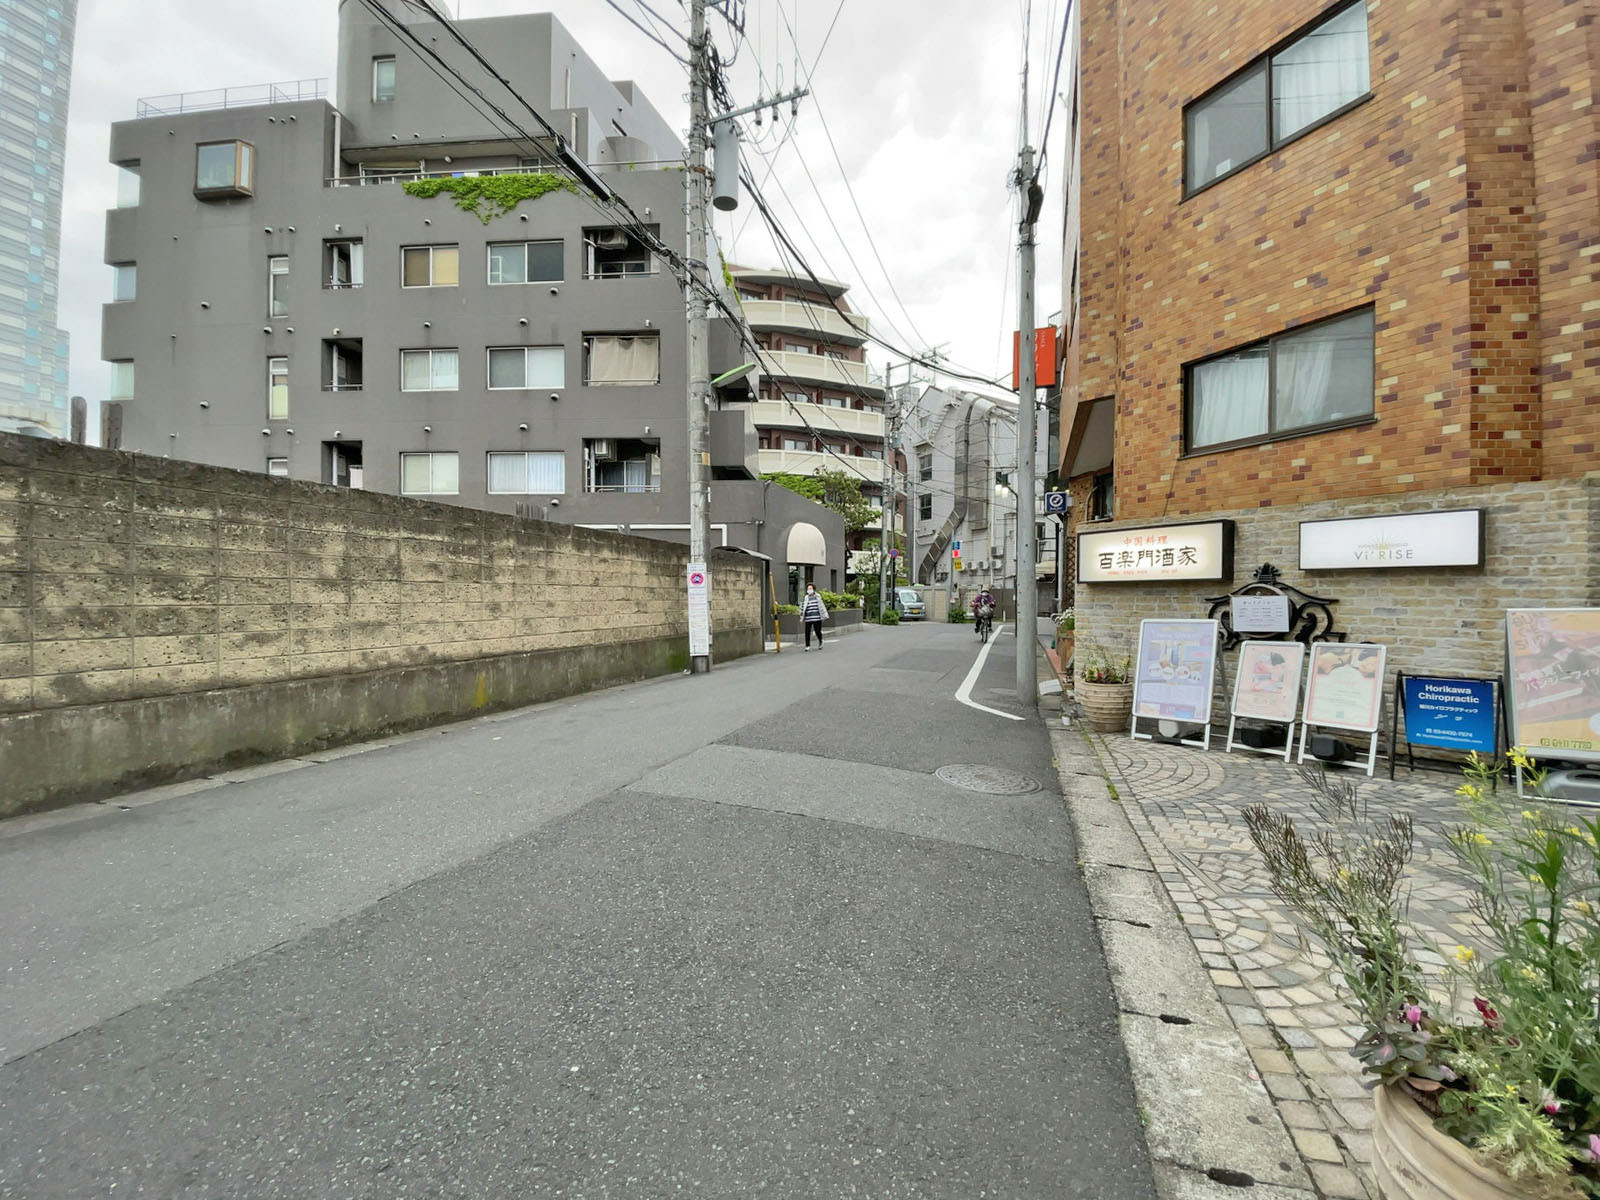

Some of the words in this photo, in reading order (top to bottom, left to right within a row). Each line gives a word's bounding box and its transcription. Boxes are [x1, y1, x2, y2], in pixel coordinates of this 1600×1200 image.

[1098, 546, 1198, 569] 百楽門酒家
[1425, 684, 1472, 694] Horikawa
[1418, 692, 1480, 703] Chiropractic
